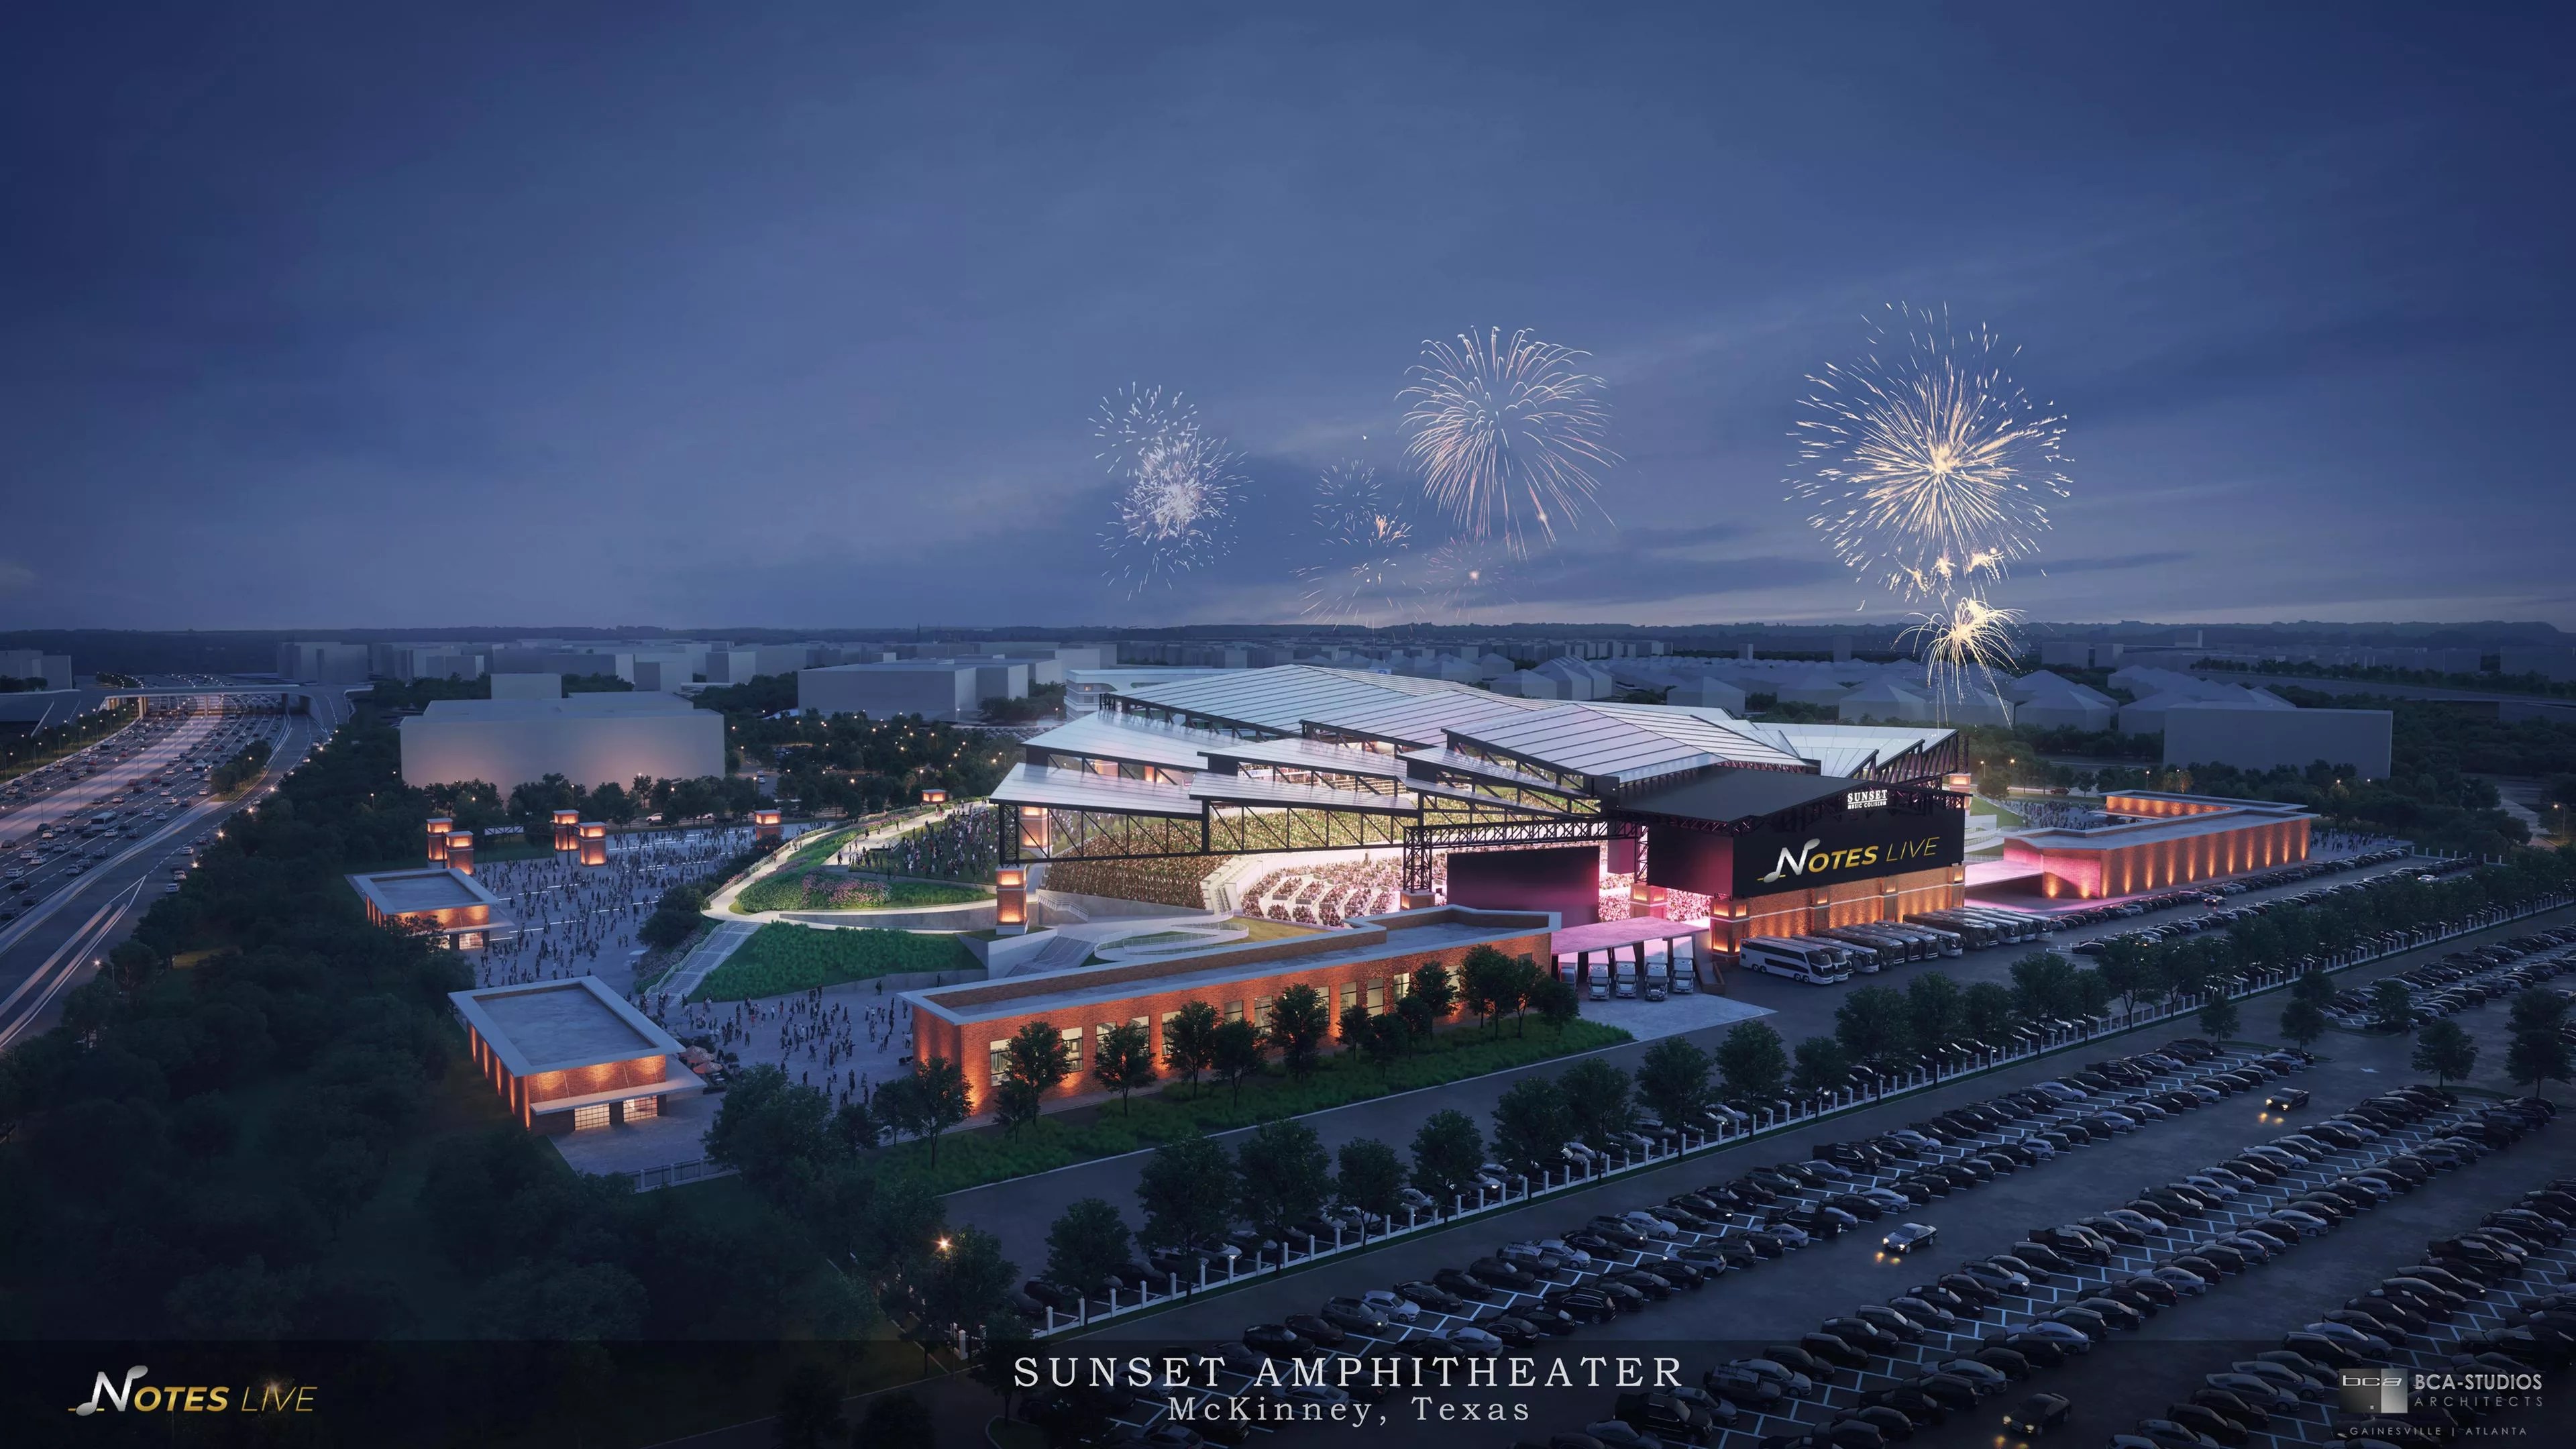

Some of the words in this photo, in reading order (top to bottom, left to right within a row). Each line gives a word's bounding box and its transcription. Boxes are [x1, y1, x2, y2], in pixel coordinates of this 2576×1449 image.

[1847, 790, 1888, 802] SUNSET
[1763, 838, 1879, 883] NOTES
[1886, 837, 1940, 862] LIVE
